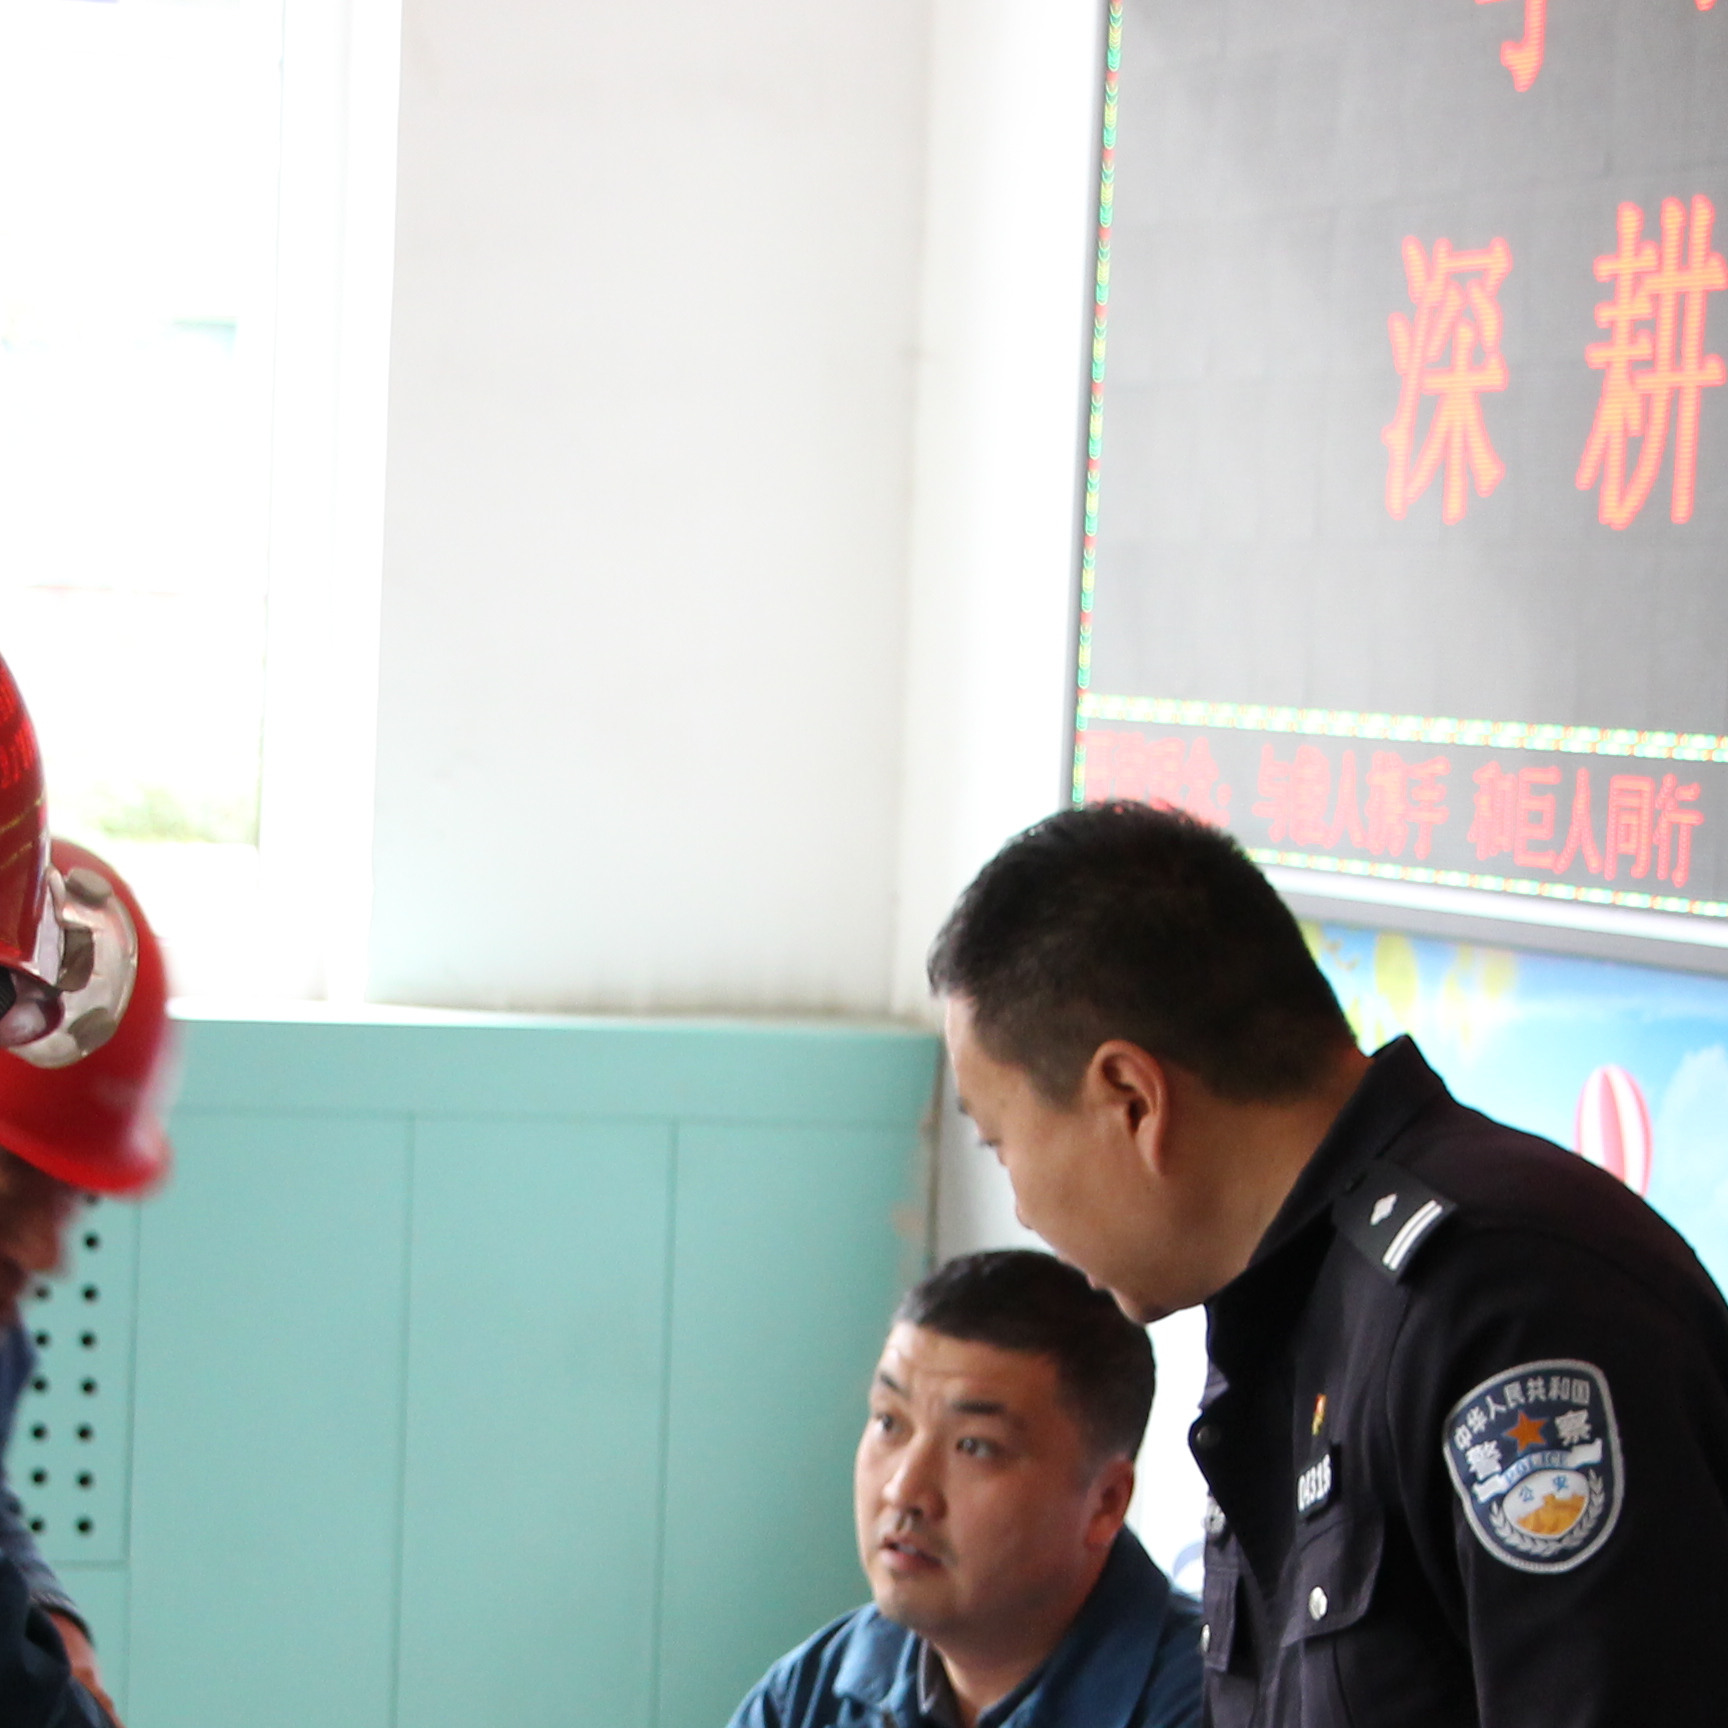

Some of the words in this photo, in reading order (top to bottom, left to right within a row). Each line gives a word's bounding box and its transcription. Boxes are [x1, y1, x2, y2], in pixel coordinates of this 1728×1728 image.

[1454, 1376, 1591, 1450] 中华人民共和国
[1505, 1451, 1569, 1485] POLICE
